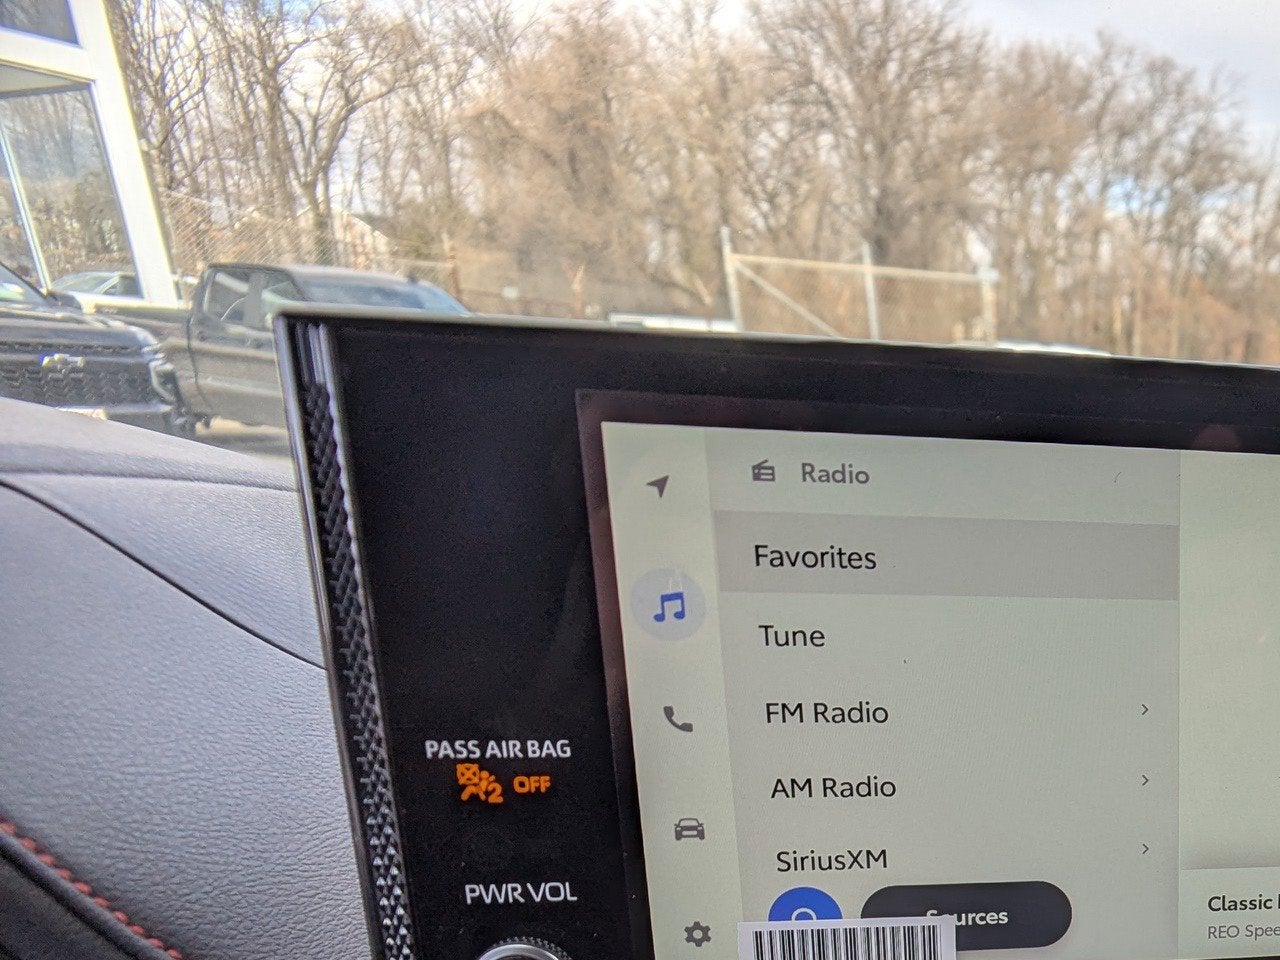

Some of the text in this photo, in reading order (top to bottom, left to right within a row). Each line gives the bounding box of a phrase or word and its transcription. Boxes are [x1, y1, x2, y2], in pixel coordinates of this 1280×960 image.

[801, 462, 870, 485] Radio
[753, 545, 877, 570] Favorites
[758, 624, 825, 648] Tune
[765, 701, 889, 724] FM Radio
[424, 739, 572, 759] PASS AIR BAG
[513, 775, 551, 793] OFF
[771, 775, 897, 799] AM Radio
[776, 849, 888, 873] SiriusXM
[464, 881, 578, 905] PWR VOL
[1207, 895, 1273, 912] Classic
[1207, 925, 1240, 940] REO
